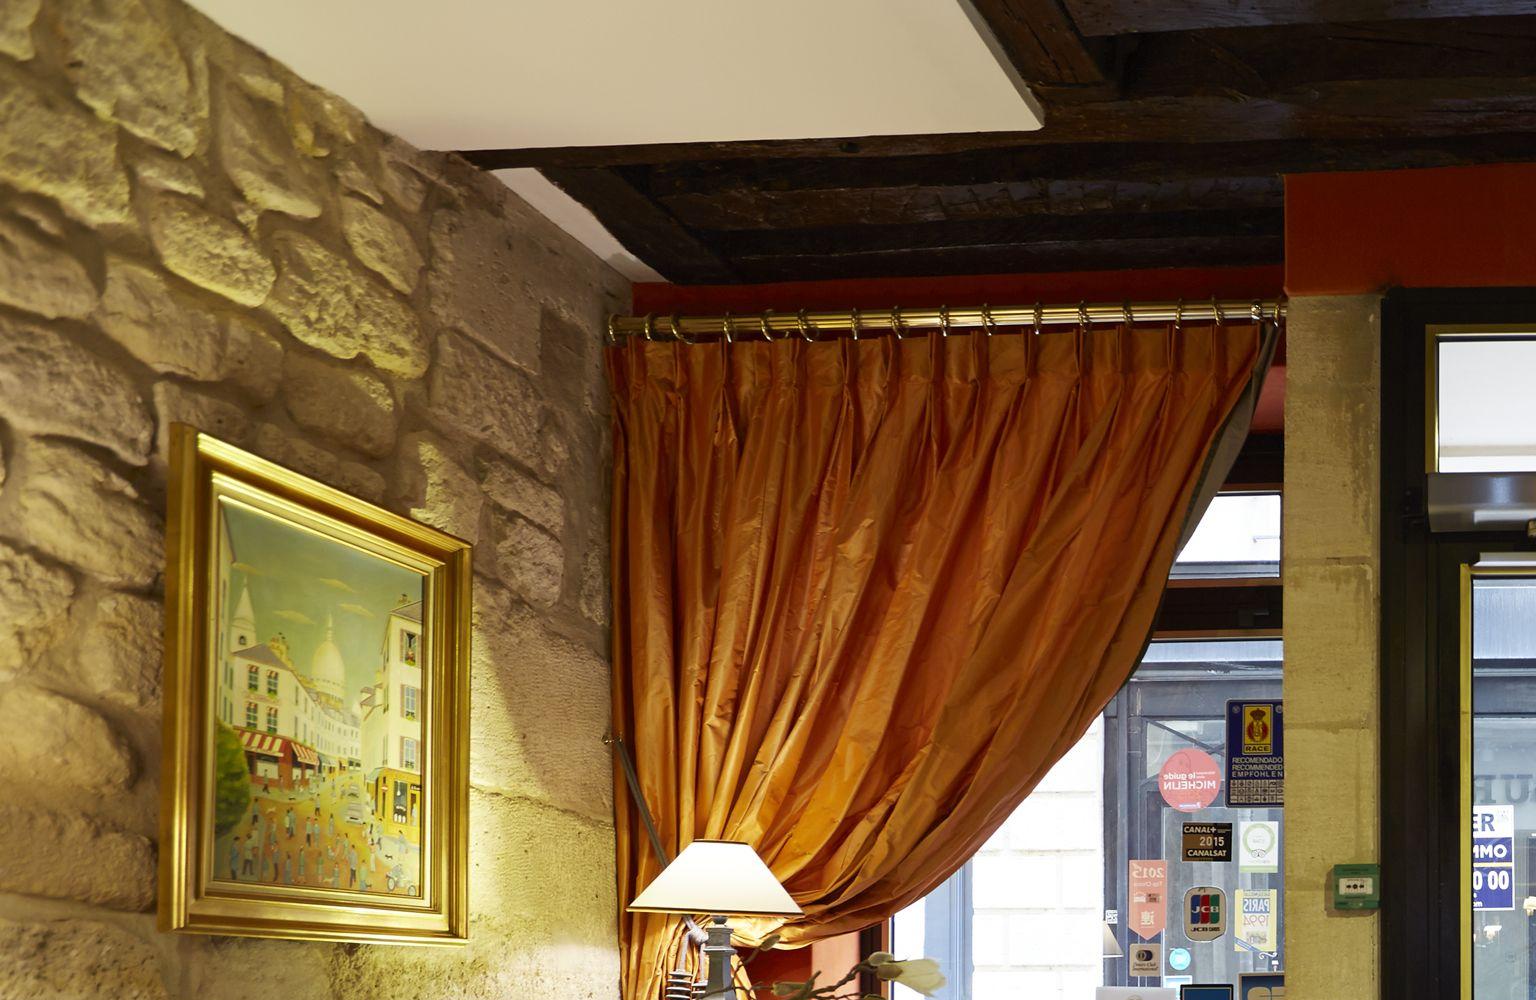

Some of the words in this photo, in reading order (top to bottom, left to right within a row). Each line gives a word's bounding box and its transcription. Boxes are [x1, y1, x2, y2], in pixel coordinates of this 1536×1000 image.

[1232, 756, 1283, 764] RECOMENDADO
[1232, 763, 1283, 771] RECOMMENDED
[1232, 770, 1283, 778] EMPFOHLEN
[1200, 836, 1225, 846] 2015
[1187, 849, 1227, 857] CANALSAT
[1488, 870, 1510, 890] 00
